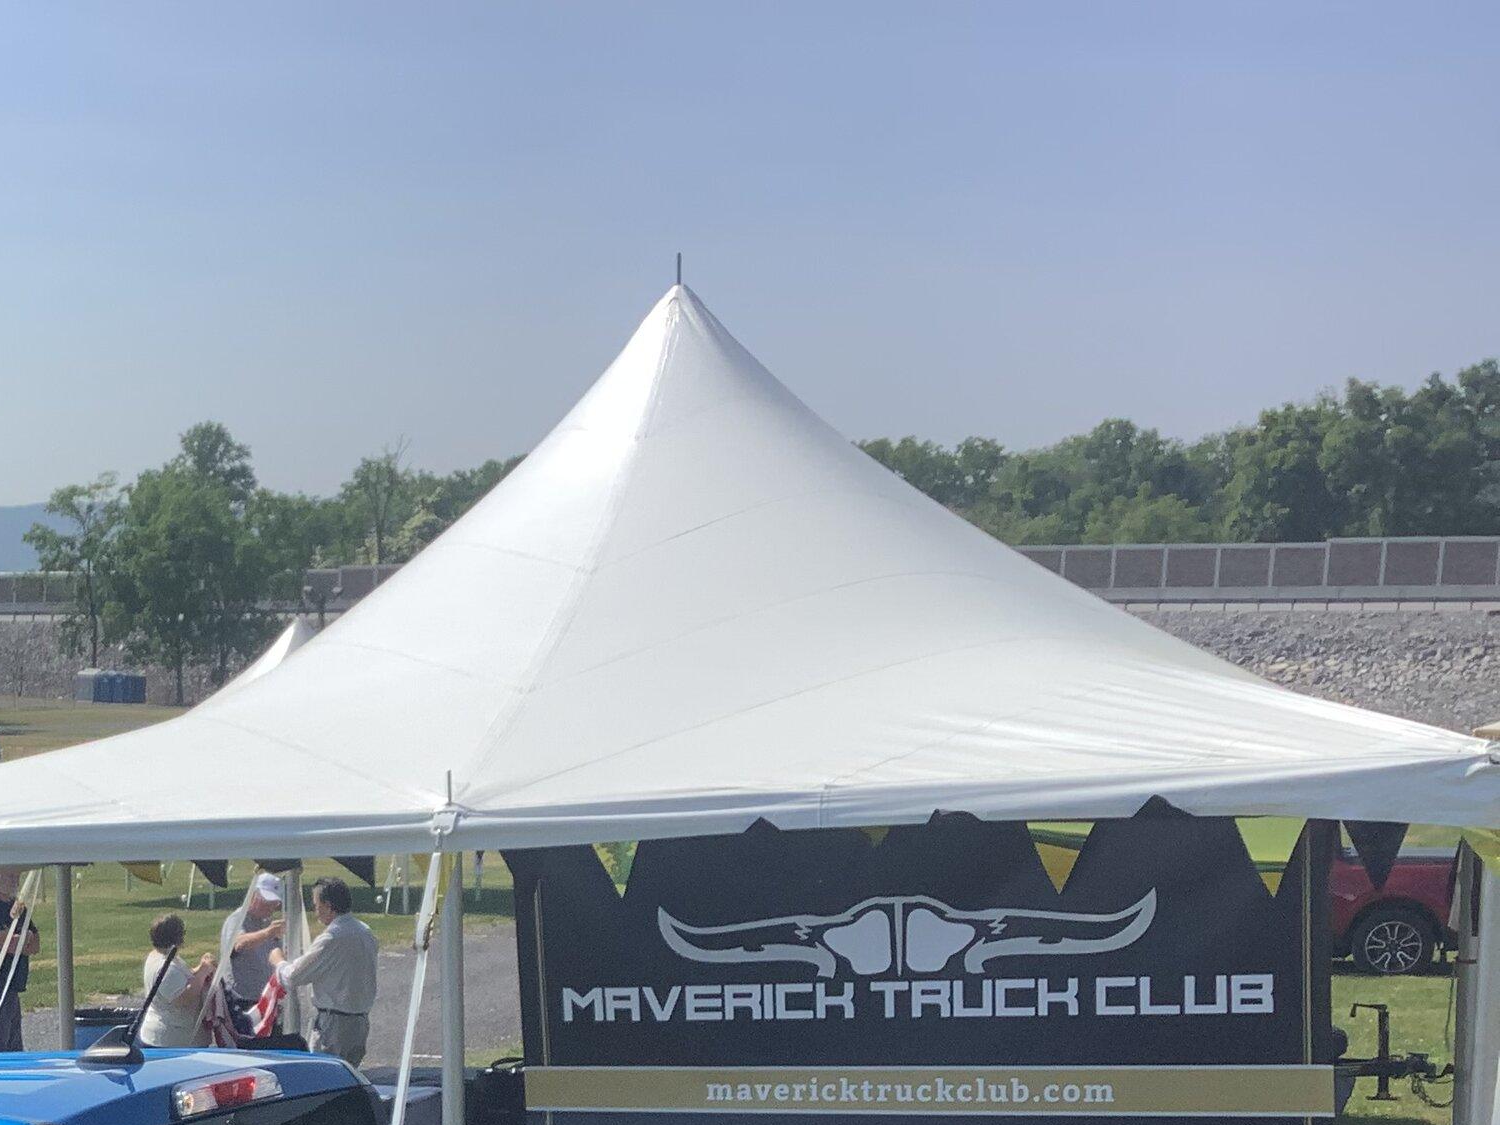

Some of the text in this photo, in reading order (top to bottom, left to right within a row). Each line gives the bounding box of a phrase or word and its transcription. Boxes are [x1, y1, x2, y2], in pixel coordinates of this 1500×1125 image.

[562, 973, 1274, 1022] MAVERICK TRUCK CLUB
[705, 1077, 1115, 1104] mavericktruckclub.com
